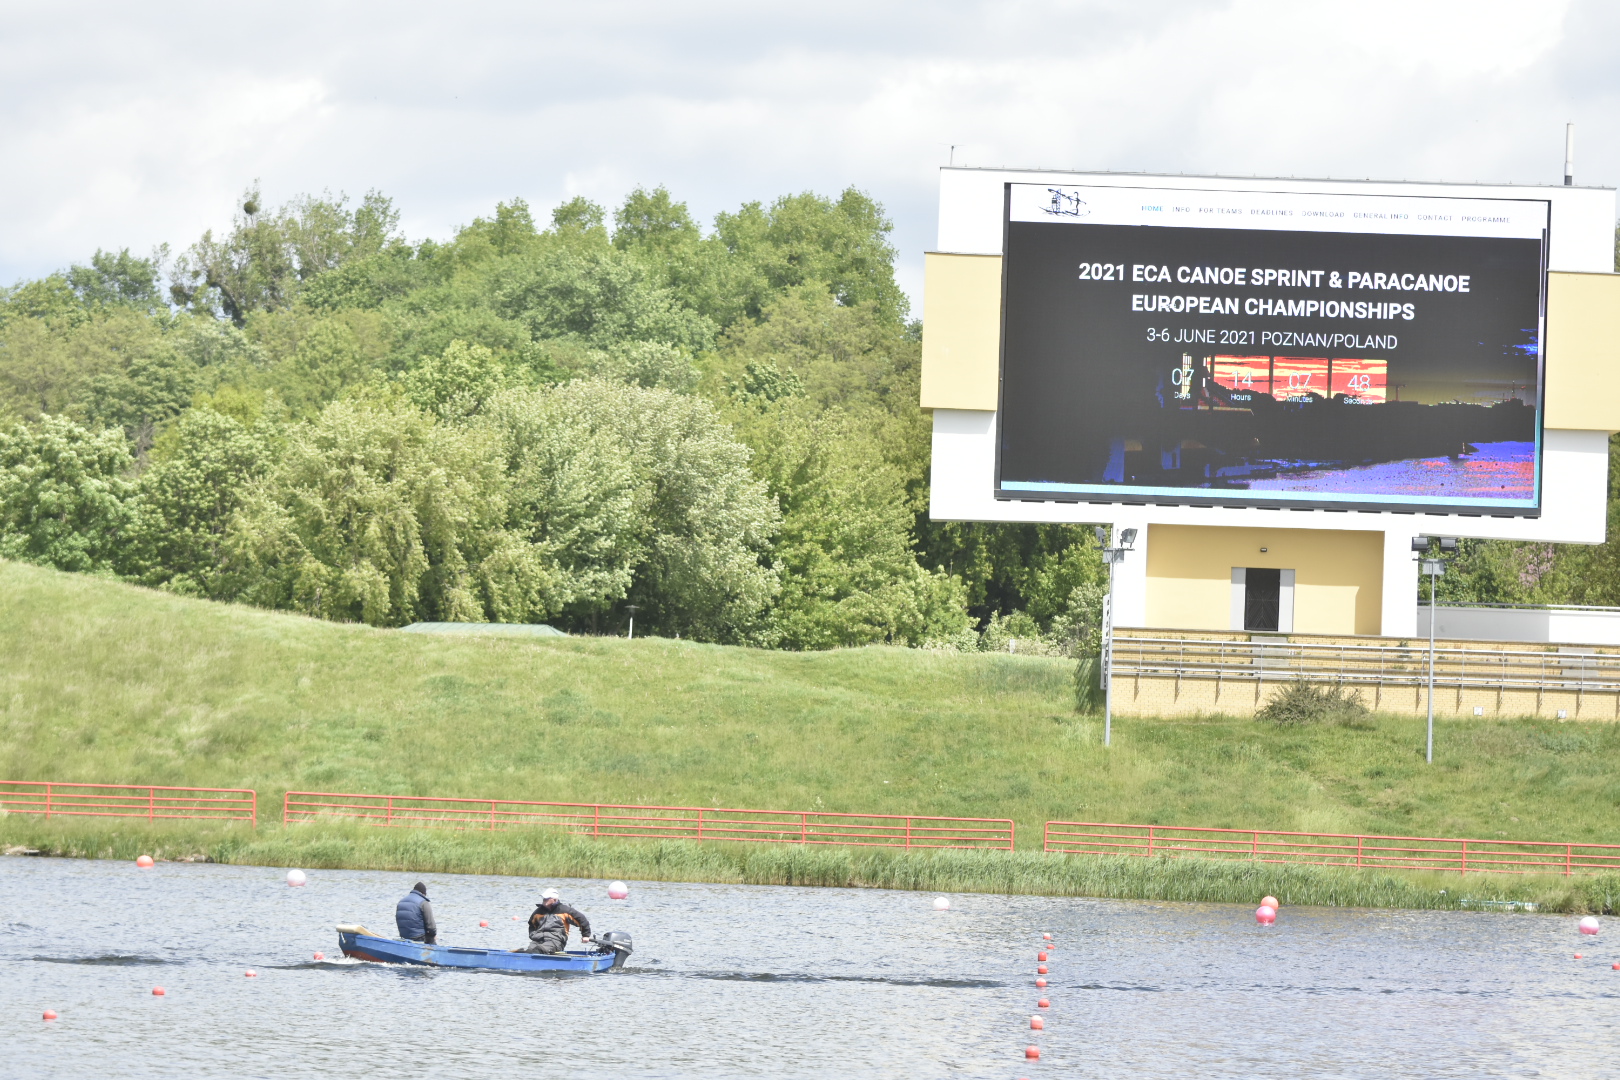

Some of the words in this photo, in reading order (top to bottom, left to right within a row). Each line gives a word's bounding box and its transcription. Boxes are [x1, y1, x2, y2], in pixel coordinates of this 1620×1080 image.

[1302, 210, 1345, 218] DOWNLOAD
[1462, 215, 1511, 223] PROGRAMME
[1078, 262, 1125, 281] 2021
[1132, 264, 1172, 283] ECA
[1177, 266, 1246, 286] CANOE
[1251, 268, 1325, 288] SPRINT
[1329, 271, 1342, 289] &
[1348, 271, 1471, 293] PARACANOE
[1132, 294, 1239, 315] EUROPEAN
[1244, 298, 1416, 321] CHAMPIONSHIPS
[1146, 327, 1170, 342] 3-6
[1174, 329, 1216, 344] JUNE
[1220, 330, 1255, 345] 2021
[1261, 331, 1398, 350] POZNAN/POLAND
[1171, 368, 1194, 386] 07
[1231, 371, 1253, 387] 14
[1288, 372, 1311, 389] 07
[1347, 375, 1371, 391] 48
[1174, 391, 1191, 400] Days
[1230, 393, 1252, 402] Hours
